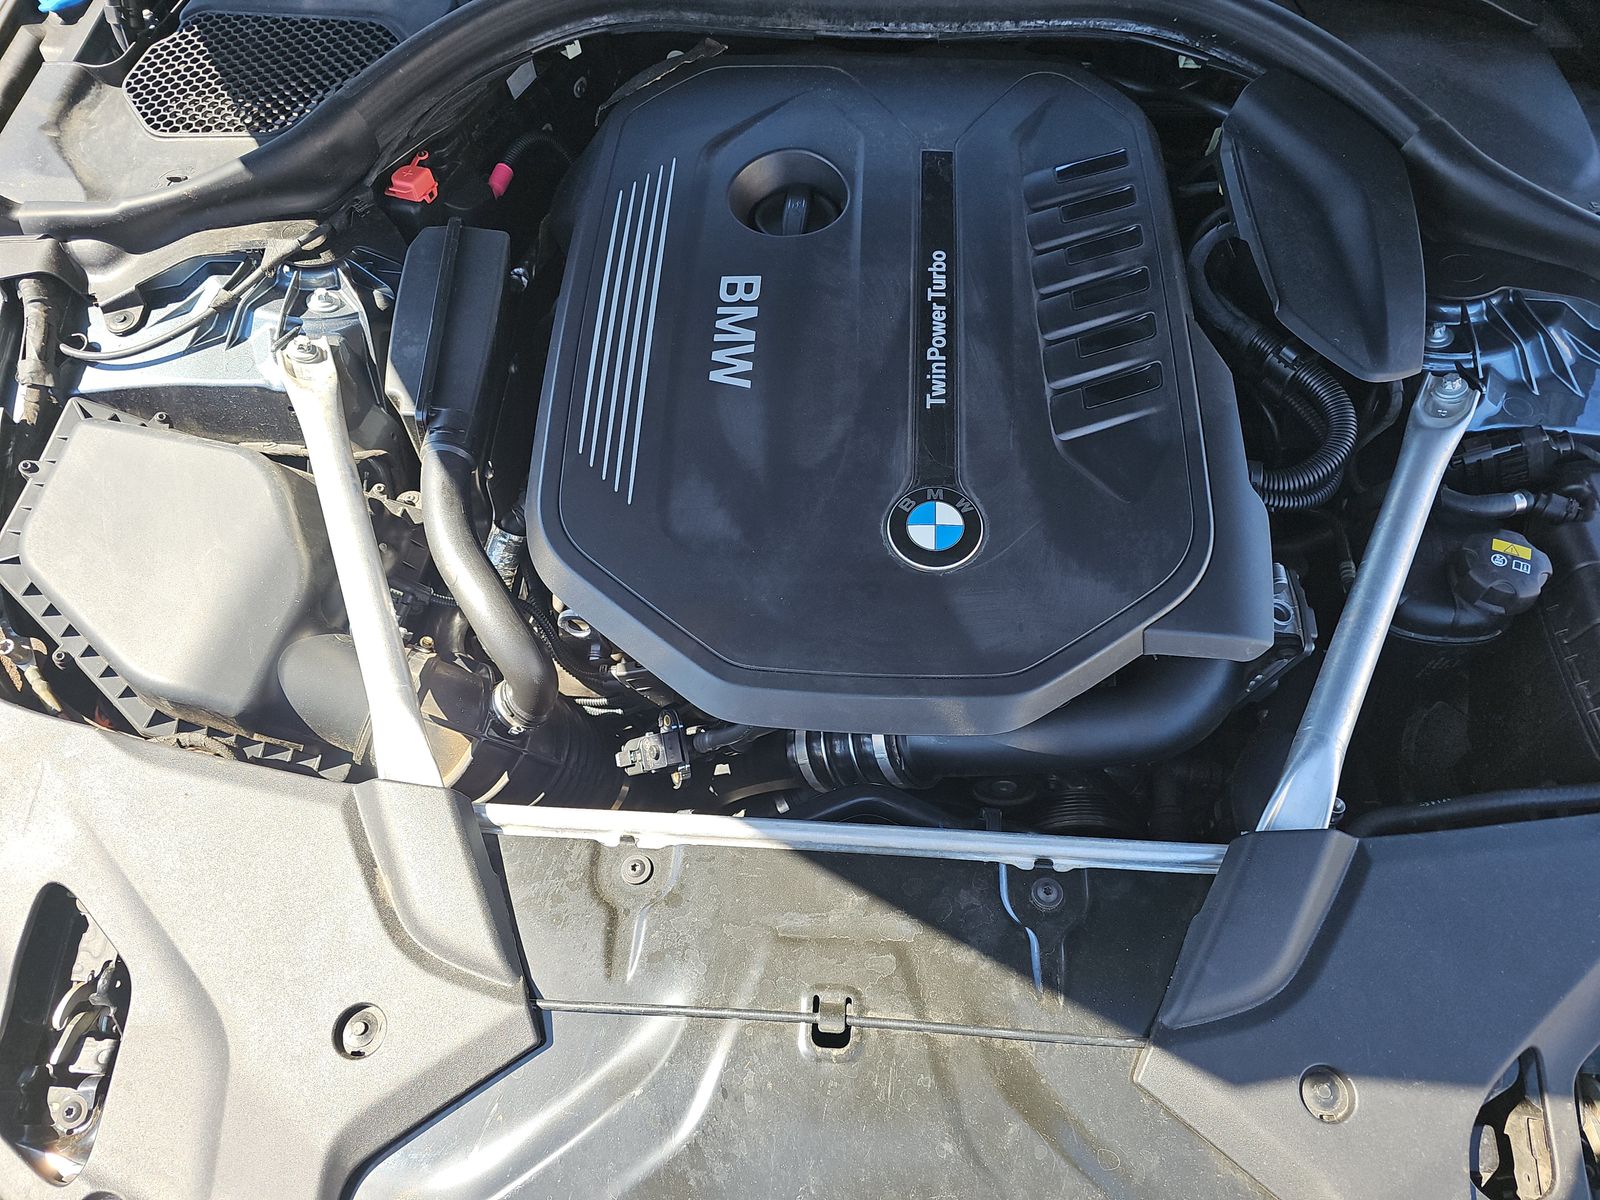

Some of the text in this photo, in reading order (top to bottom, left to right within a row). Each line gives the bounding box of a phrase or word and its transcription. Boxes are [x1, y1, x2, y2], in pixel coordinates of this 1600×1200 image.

[708, 275, 762, 389] BMW
[926, 250, 947, 409] TwinPower Turbo
[897, 488, 975, 513] BMW
